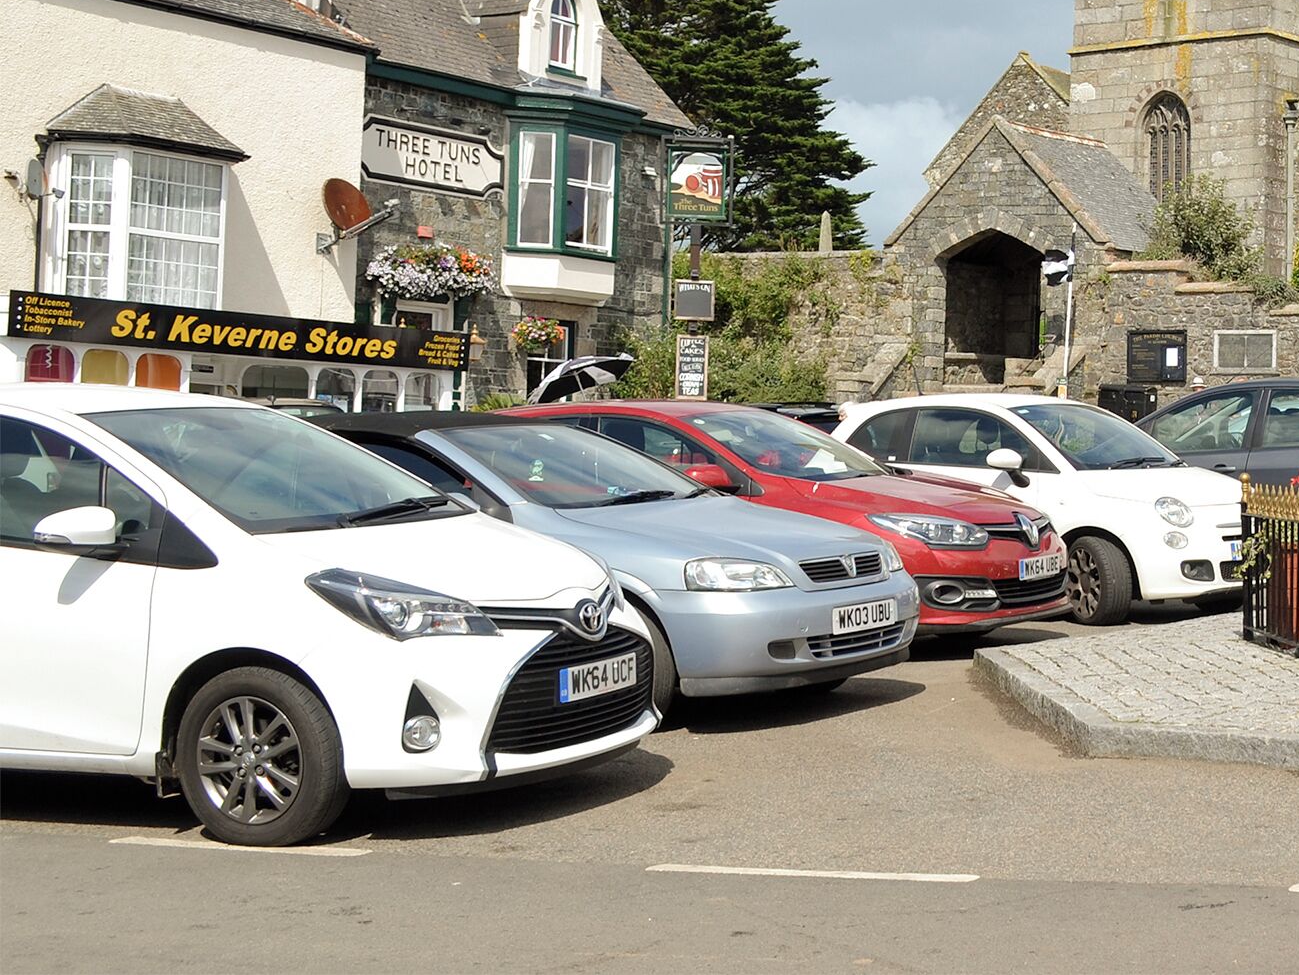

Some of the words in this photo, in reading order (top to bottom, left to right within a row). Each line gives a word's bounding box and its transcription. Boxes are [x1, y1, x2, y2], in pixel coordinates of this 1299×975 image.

[375, 128, 431, 156] THREE
[437, 139, 481, 165] TUNS
[405, 156, 463, 183] HOTEL
[673, 202, 698, 211] Three
[698, 203, 719, 212] Tuns
[24, 305, 73, 317] Tobacconist
[25, 295, 39, 305] Off
[39, 297, 71, 308] Licence
[23, 323, 53, 335] Lottery
[24, 314, 57, 325] In-Store
[57, 316, 86, 329] Bakery
[111, 308, 157, 340] St.
[167, 314, 298, 353] Keverne
[304, 326, 398, 360] Stores
[838, 606, 869, 629] WK03
[870, 603, 891, 623] UBU
[571, 663, 608, 695] WK64
[611, 656, 634, 685] UCF
